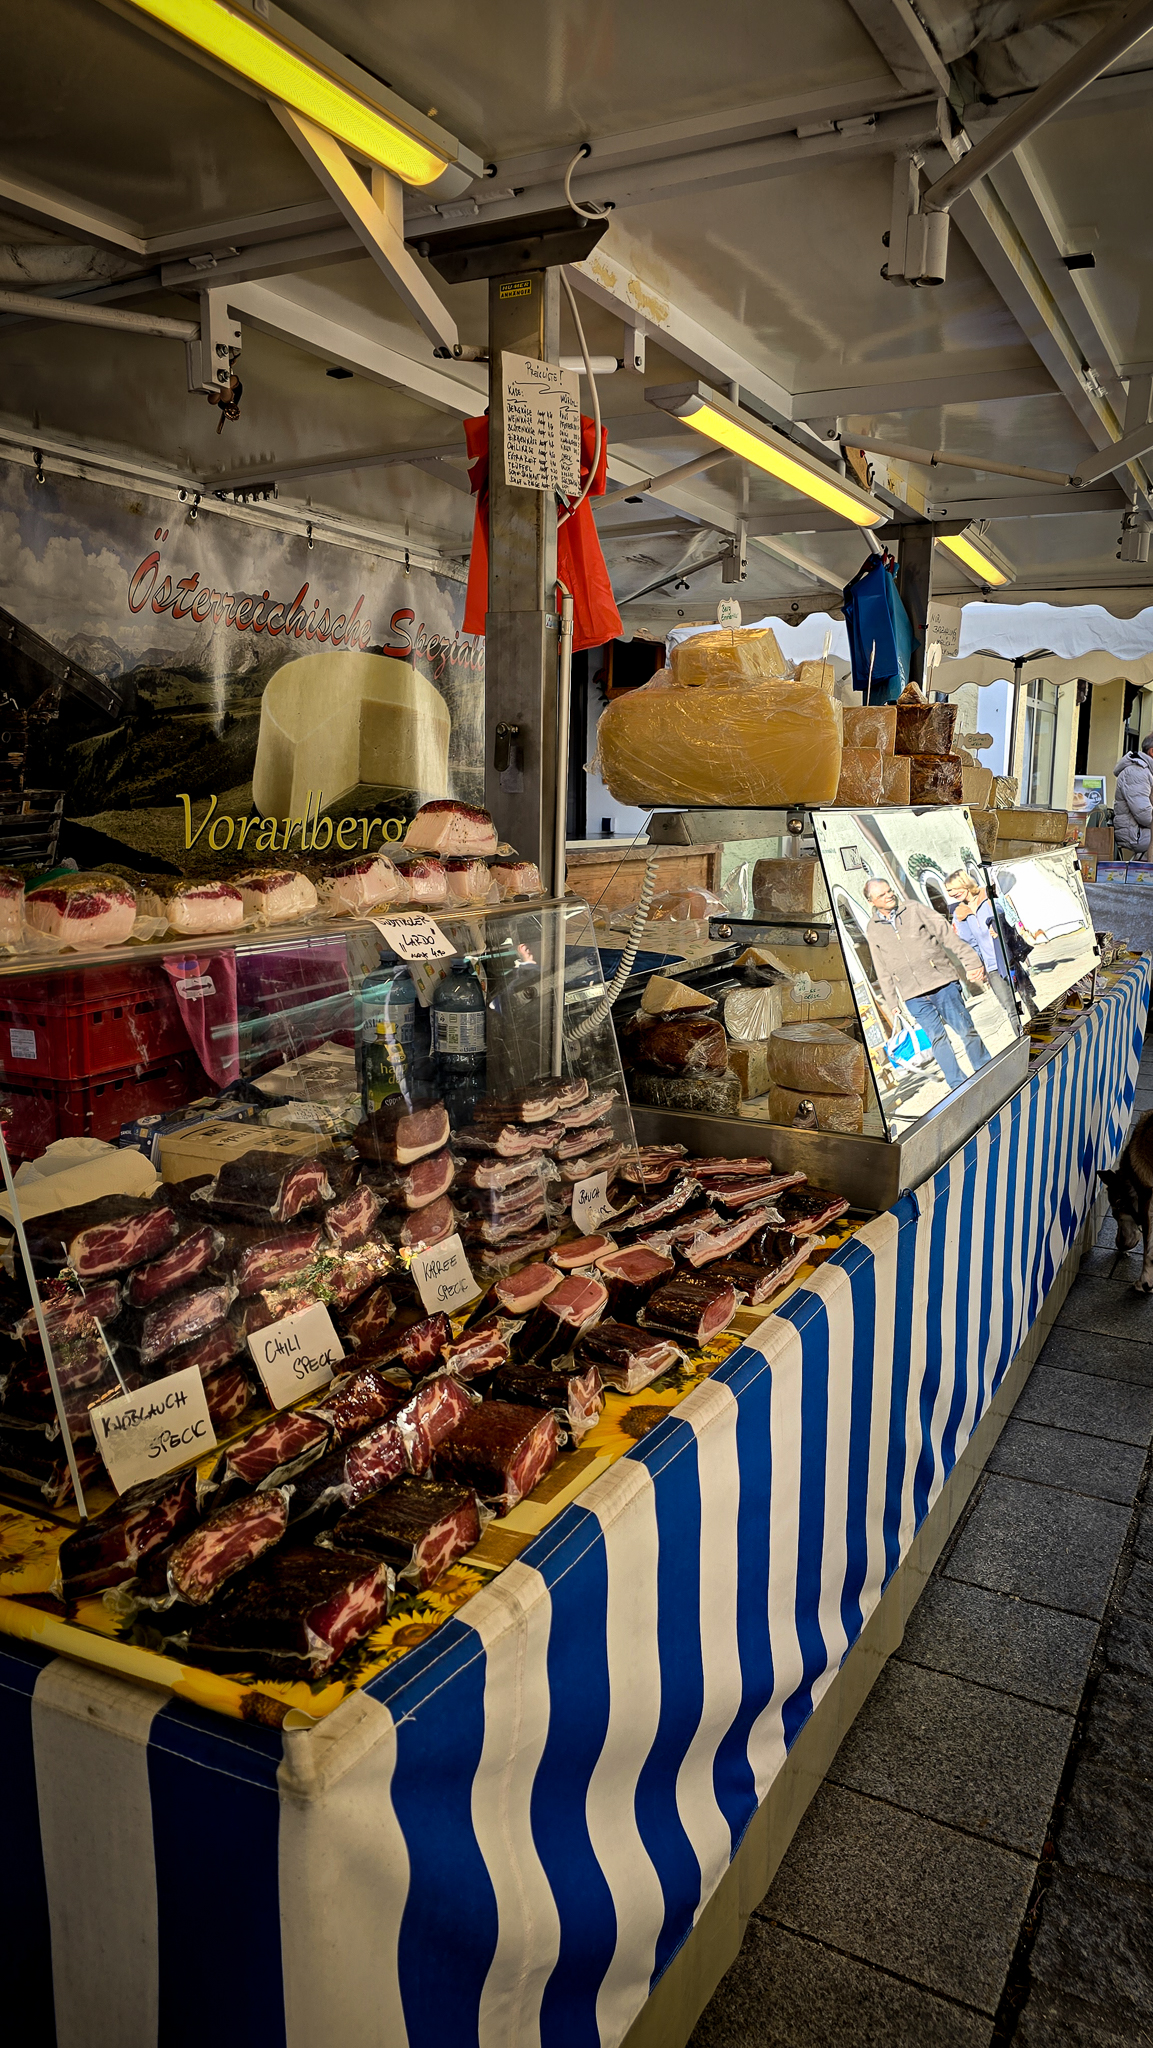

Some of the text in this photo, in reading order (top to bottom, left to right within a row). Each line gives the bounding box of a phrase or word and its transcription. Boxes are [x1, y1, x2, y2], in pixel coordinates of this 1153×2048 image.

[128, 528, 486, 680] Österreichische Speziali
[579, 1186, 600, 1205] BAUCH
[421, 1254, 458, 1282] KARREE
[436, 1278, 469, 1302] SPECK
[264, 1321, 302, 1364] CHILI
[293, 1348, 337, 1380] SPECK
[101, 1390, 188, 1439] KNOBLAUCH
[148, 1419, 207, 1459] SPECK
